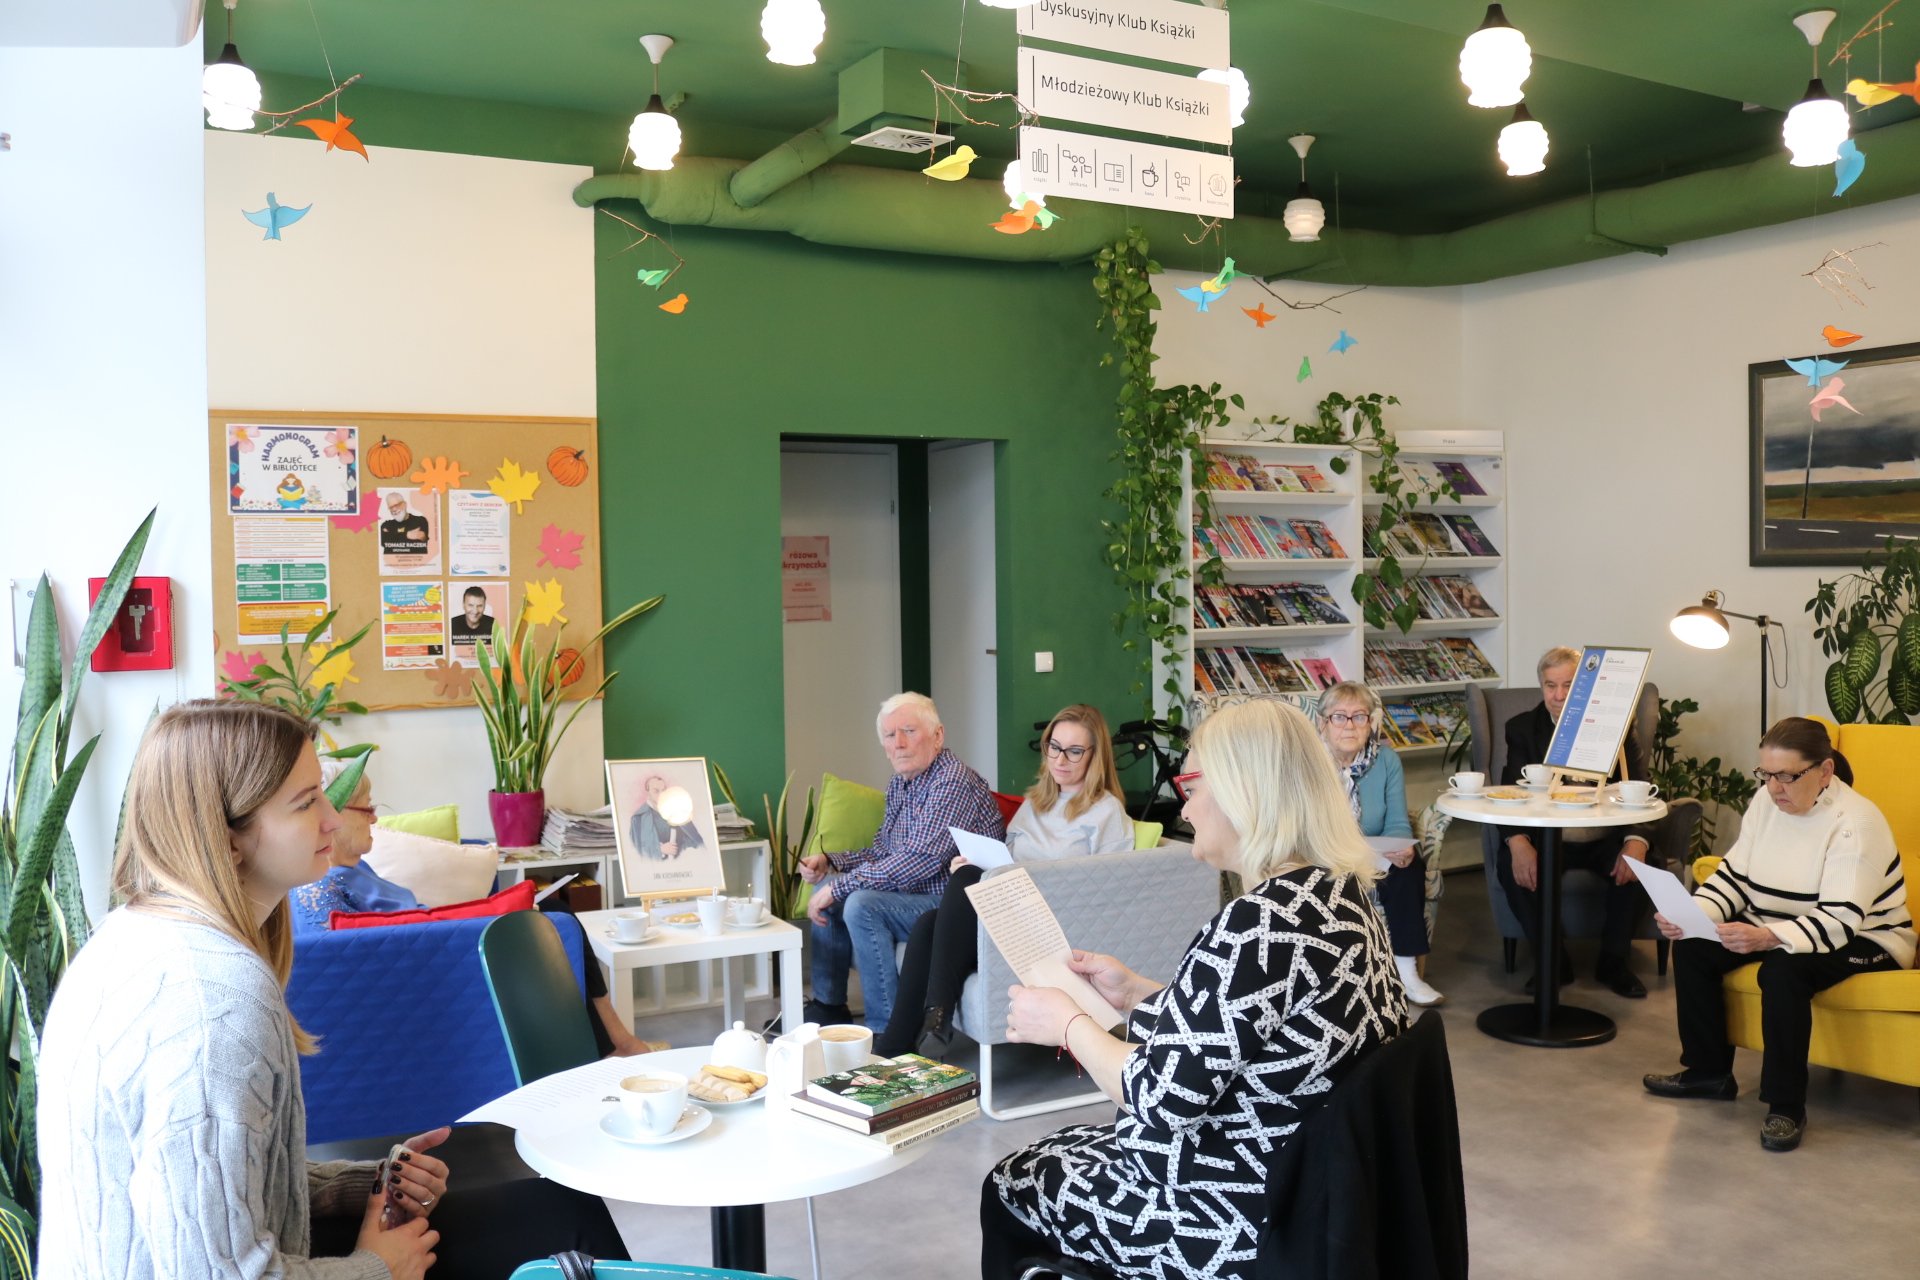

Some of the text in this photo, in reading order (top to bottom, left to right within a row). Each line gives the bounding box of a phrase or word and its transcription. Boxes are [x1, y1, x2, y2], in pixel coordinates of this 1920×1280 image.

[1040, 0, 1196, 40] Dyskusyjny Klub Książki
[1041, 75, 1210, 116] Młodzieżowy Klub Książki
[261, 432, 320, 462] HARMONOGRAM
[277, 455, 303, 464] ZAJĘĆ
[789, 551, 818, 559] różowa
[782, 560, 827, 571] krzyneczka
